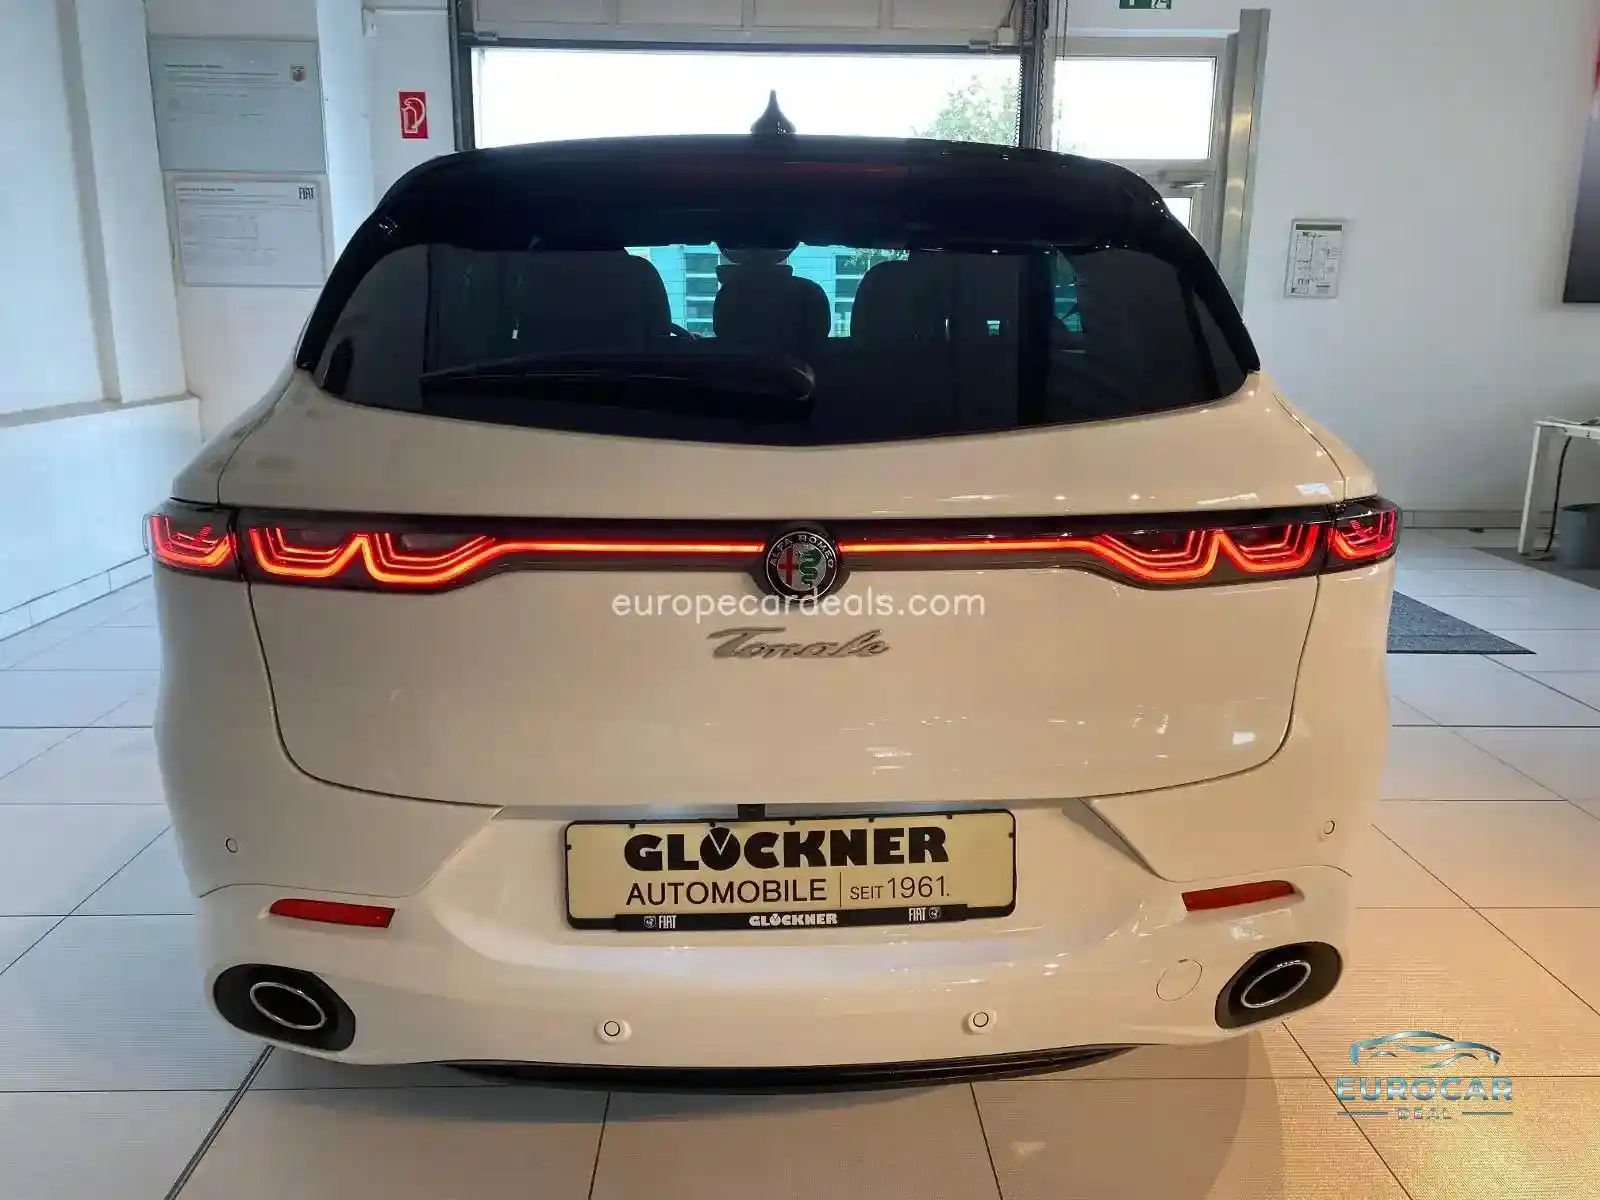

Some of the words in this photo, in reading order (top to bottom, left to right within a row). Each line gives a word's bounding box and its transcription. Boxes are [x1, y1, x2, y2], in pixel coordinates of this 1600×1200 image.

[299, 187, 314, 200] FIAT
[770, 538, 793, 566] ALFA
[798, 534, 834, 568] ROMEO
[706, 626, 891, 659] Tonale
[624, 826, 949, 871] GLÖCKNER
[626, 878, 827, 906] AUTOMOBILE
[850, 884, 884, 901] SEIT
[887, 875, 950, 899] 1961.
[658, 914, 677, 929] FIAT
[749, 912, 838, 927] GLÖCKNER
[908, 906, 926, 922] FIAT
